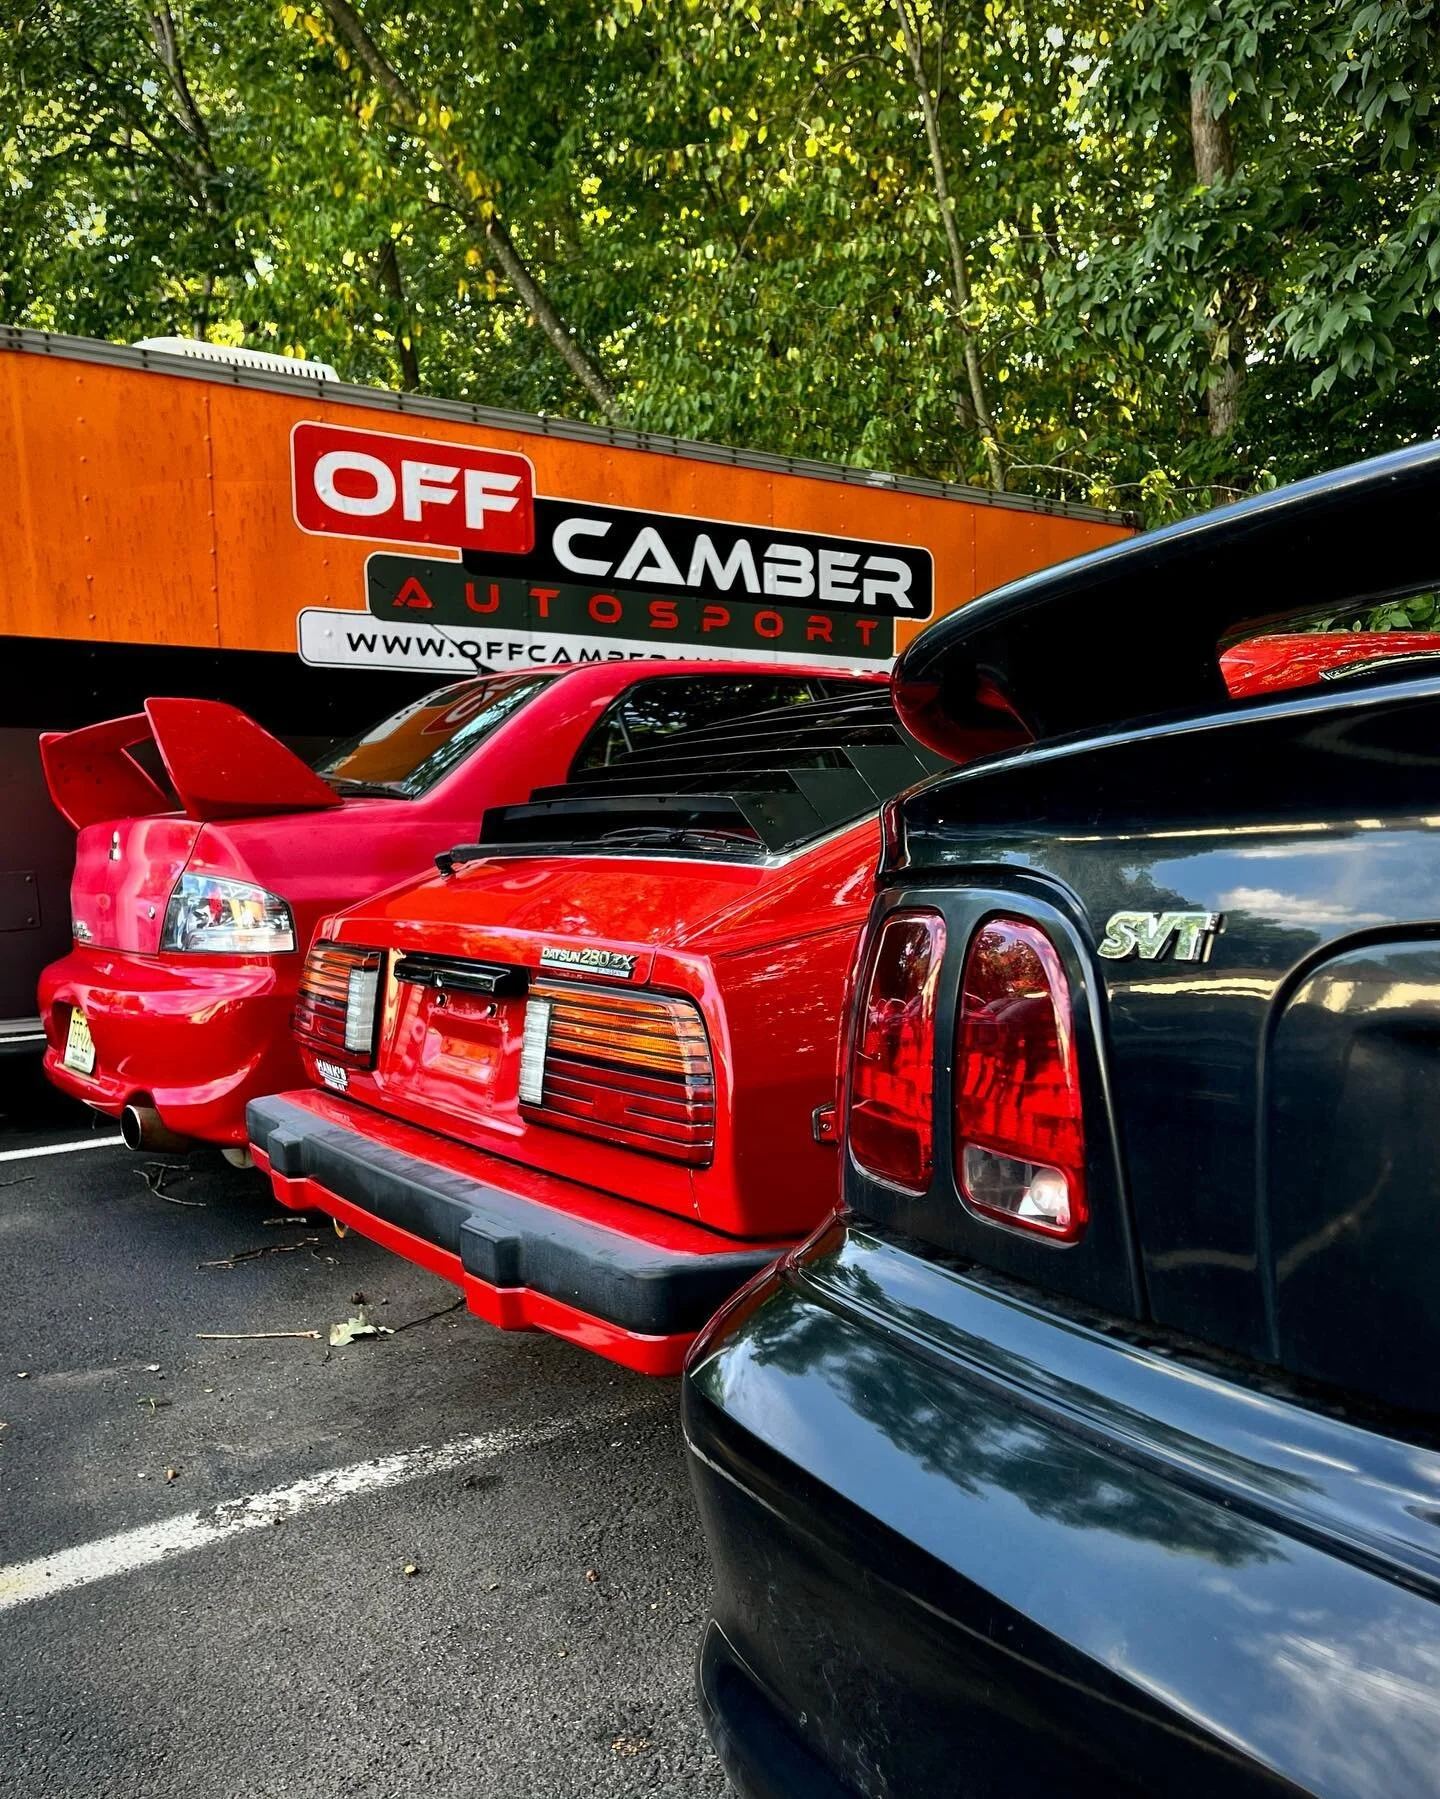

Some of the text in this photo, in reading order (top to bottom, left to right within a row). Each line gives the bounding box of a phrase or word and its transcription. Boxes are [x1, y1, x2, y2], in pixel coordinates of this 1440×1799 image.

[313, 450, 522, 530] OFF
[552, 517, 914, 609] CAMBER
[393, 576, 880, 647] AUTOSPORT
[541, 946, 580, 963] DATSUN
[1097, 911, 1214, 961] SVT
